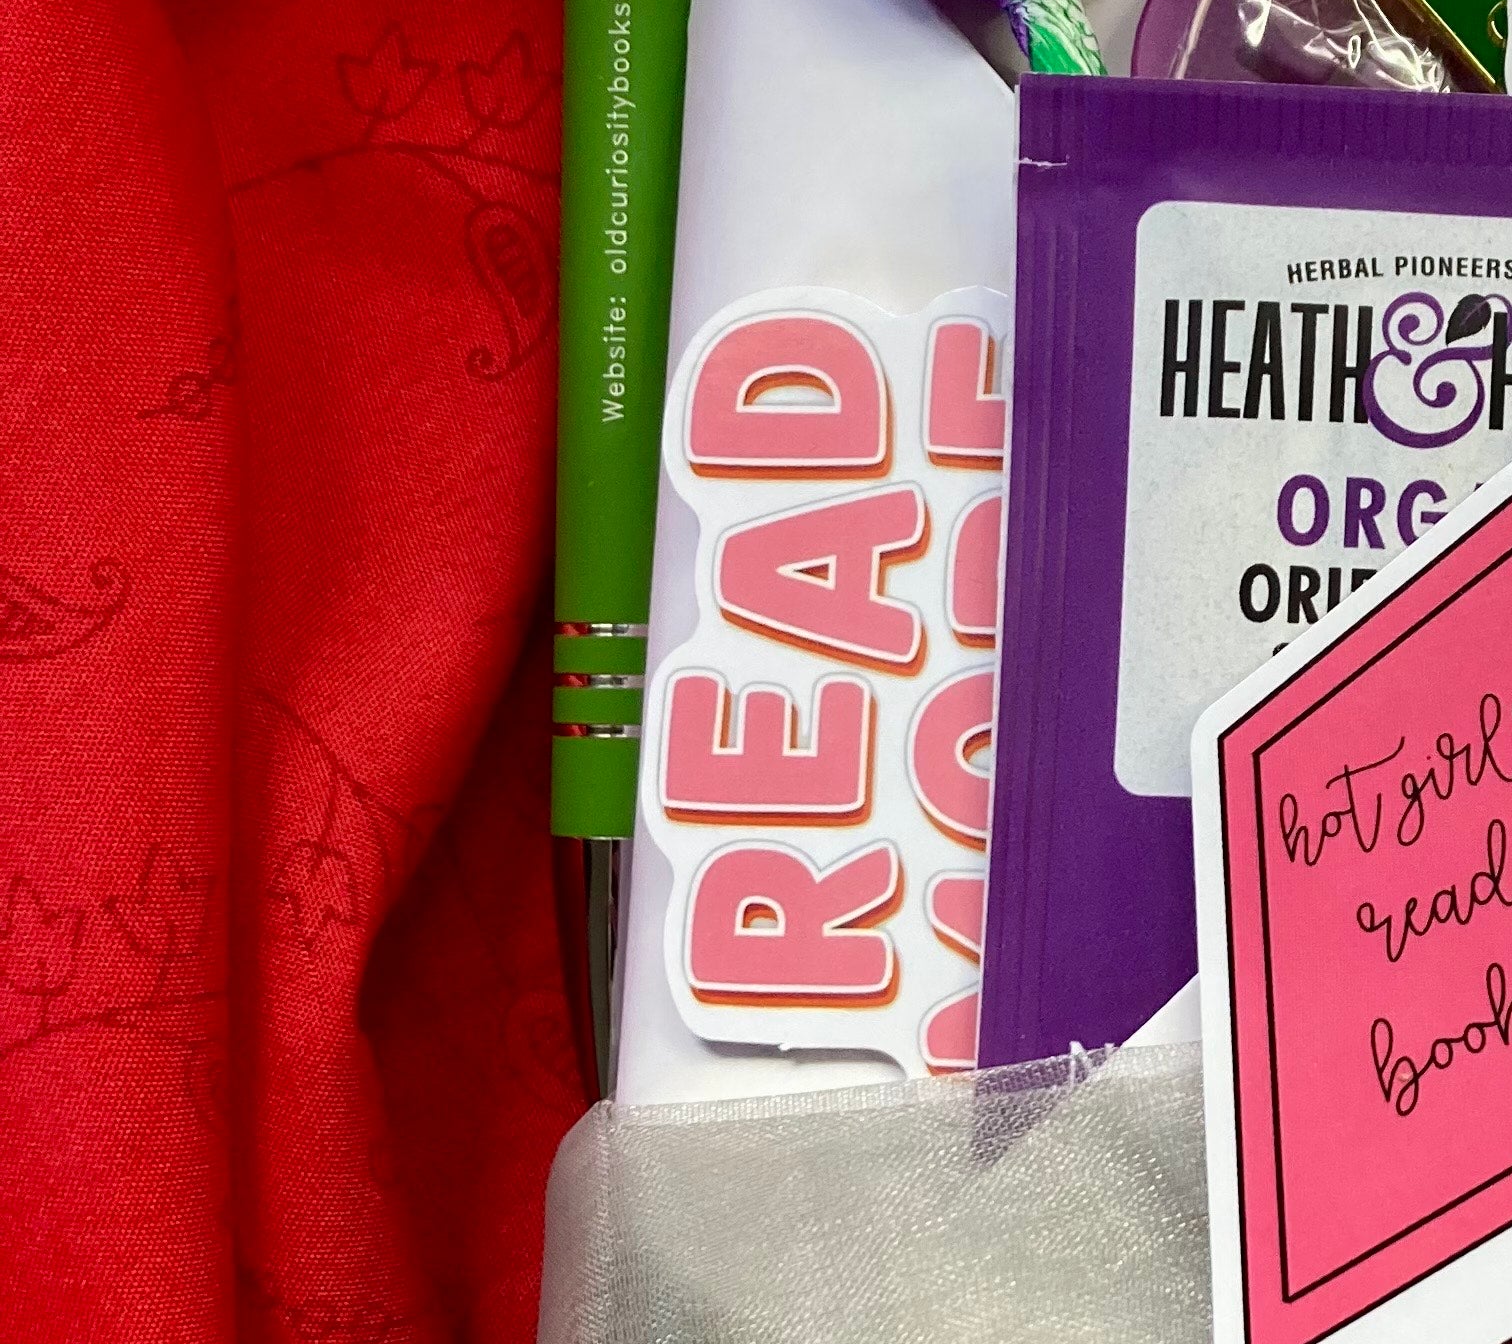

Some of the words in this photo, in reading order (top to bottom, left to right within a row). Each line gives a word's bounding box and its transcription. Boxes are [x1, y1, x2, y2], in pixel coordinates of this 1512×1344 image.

[1287, 257, 1384, 284] HERBAL
[602, 295, 628, 424] Website:
[1159, 298, 1374, 424] HEATH
[1276, 473, 1484, 550] ORG
[660, 310, 930, 1009] READ
[1279, 736, 1406, 866] hot
